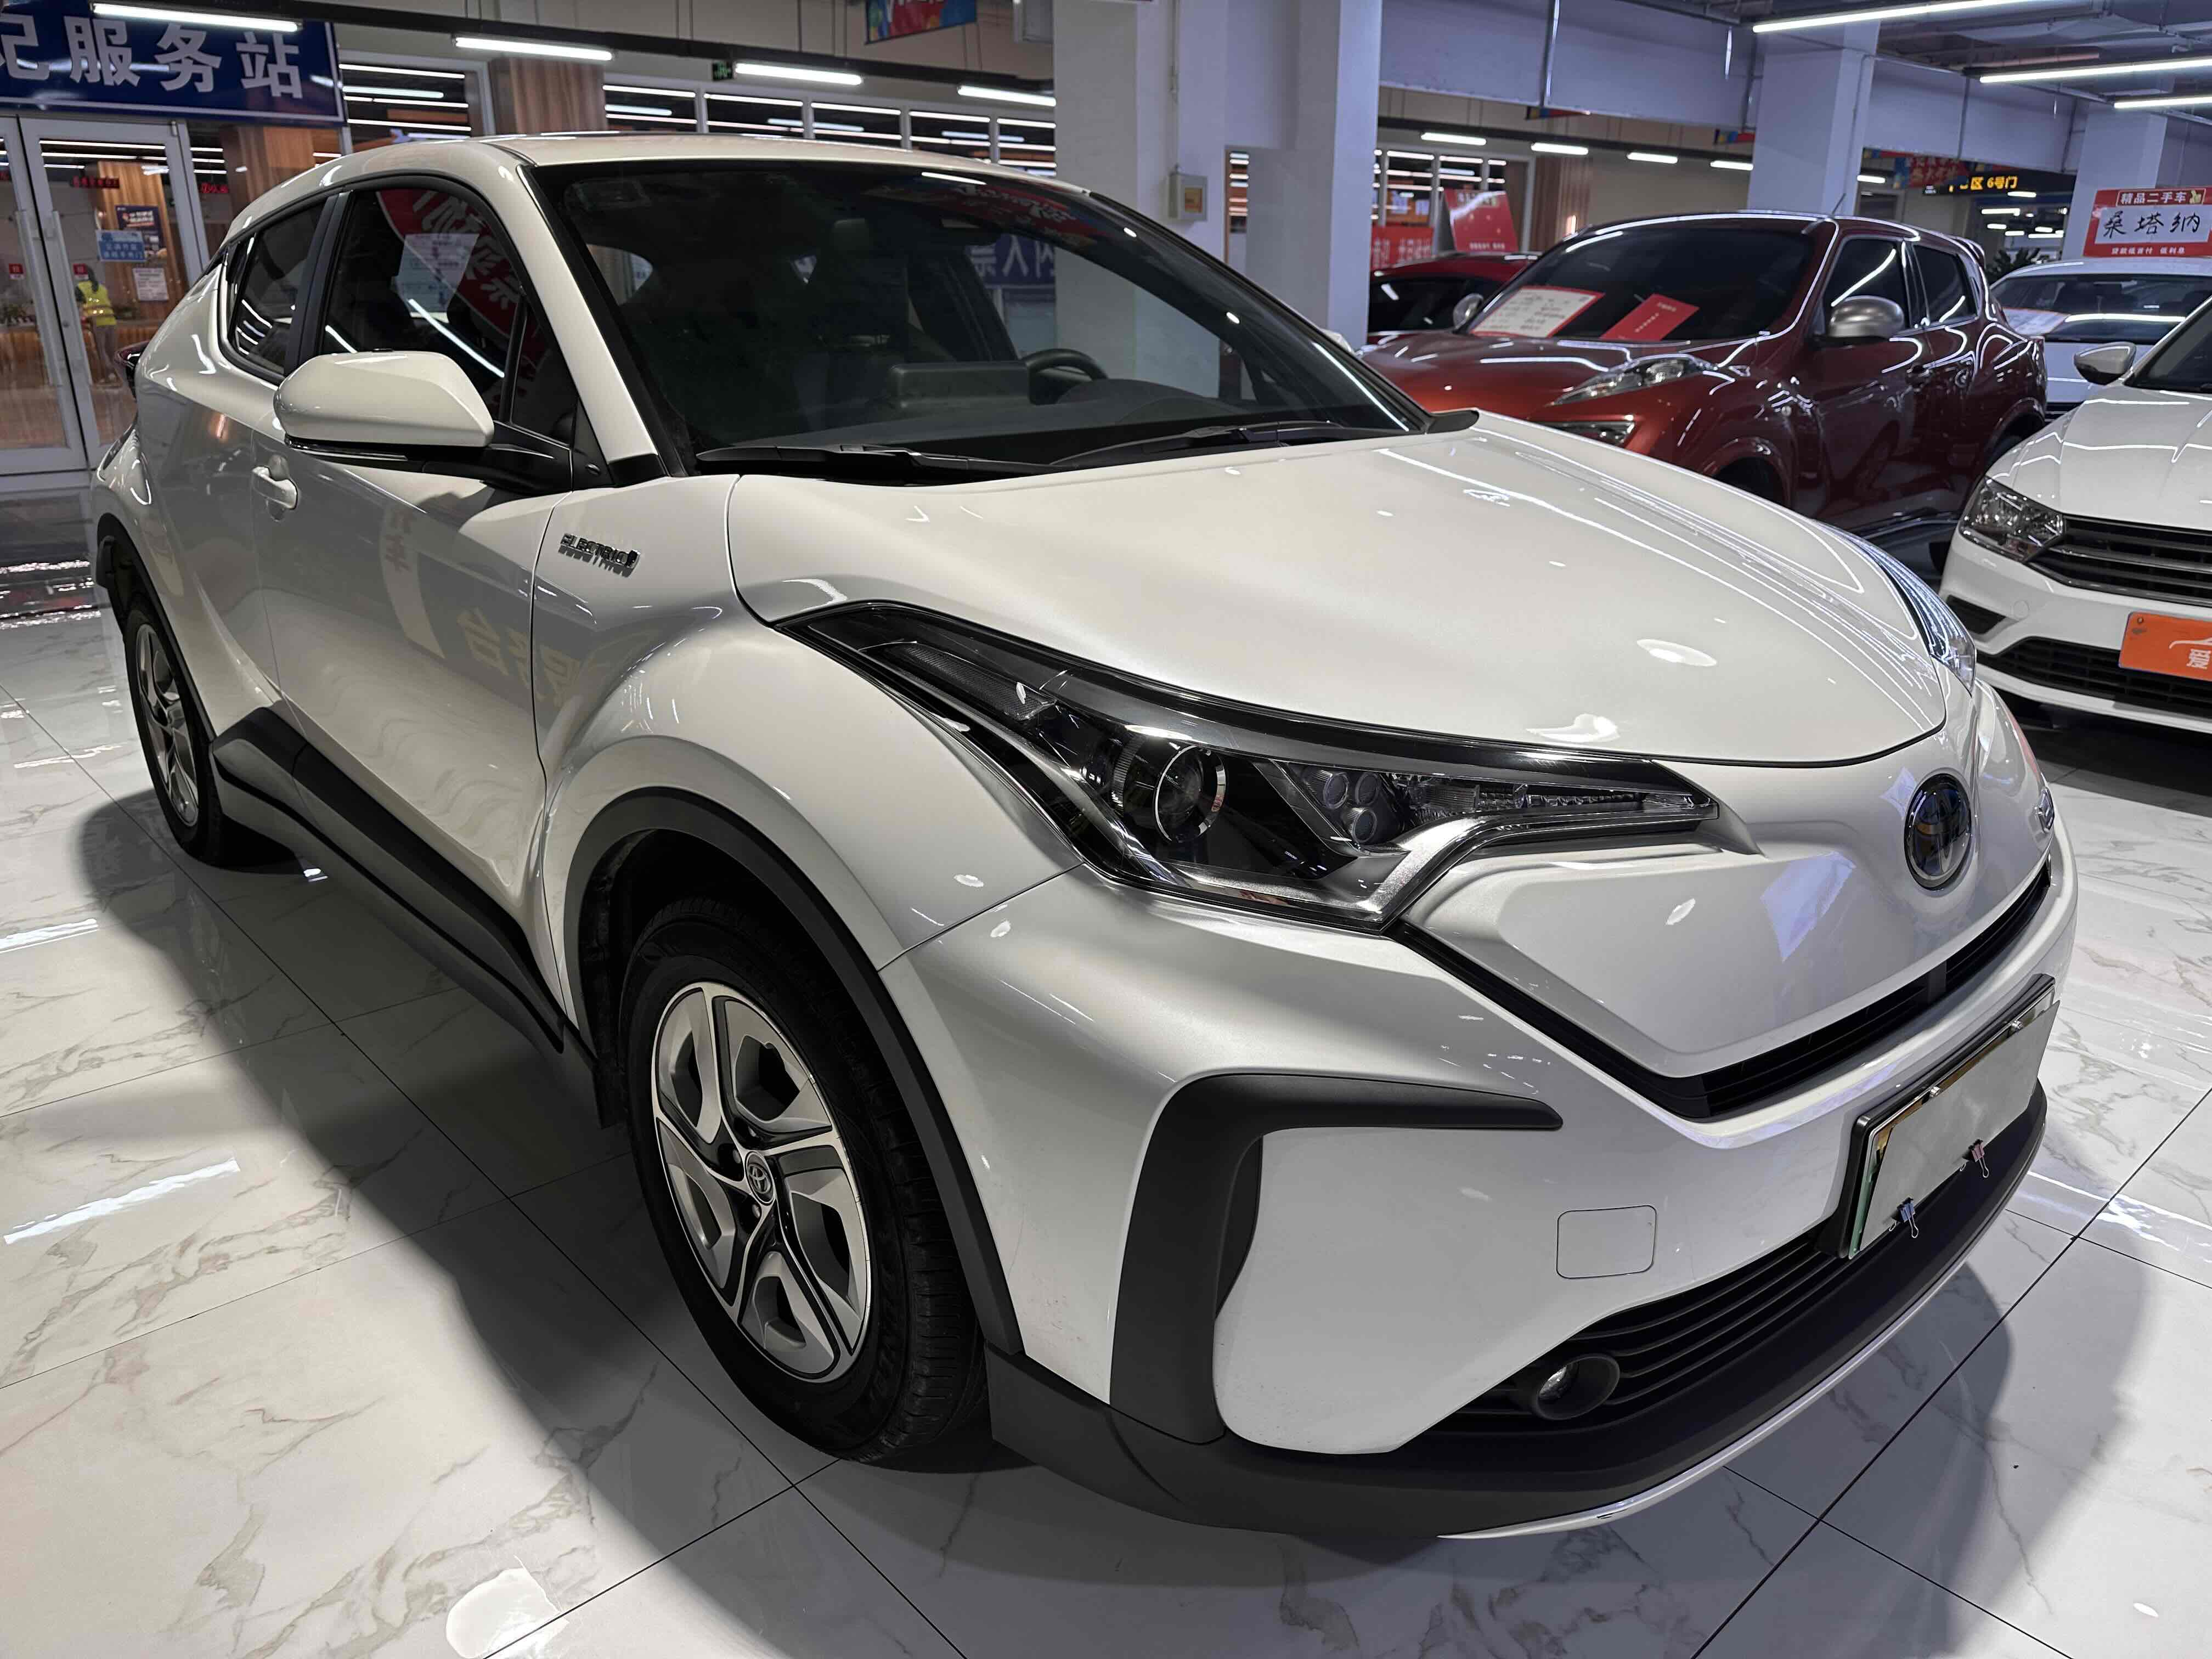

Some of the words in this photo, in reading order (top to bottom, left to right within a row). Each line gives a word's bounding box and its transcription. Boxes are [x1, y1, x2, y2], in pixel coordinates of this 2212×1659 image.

[2120, 191, 2187, 204] 精品二手车
